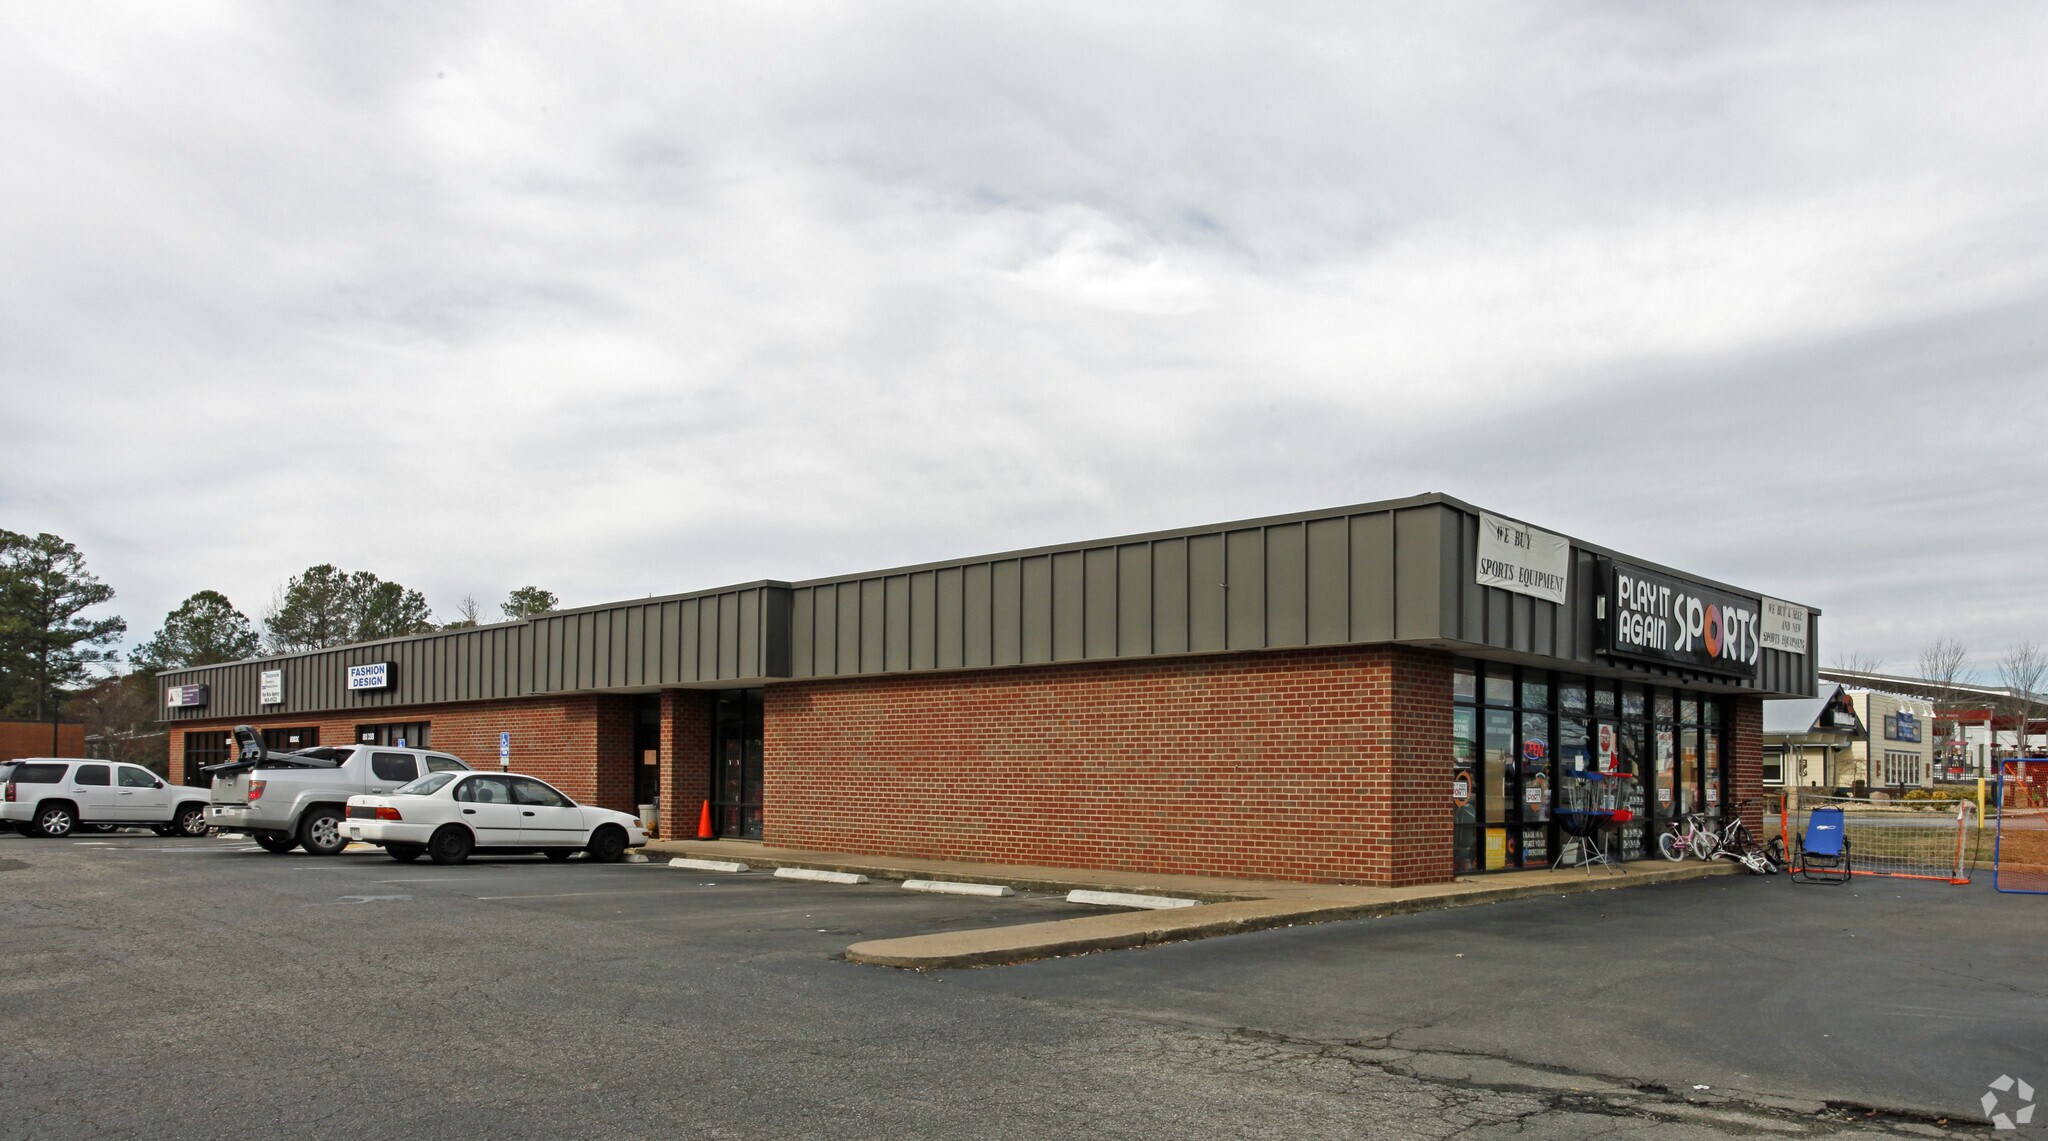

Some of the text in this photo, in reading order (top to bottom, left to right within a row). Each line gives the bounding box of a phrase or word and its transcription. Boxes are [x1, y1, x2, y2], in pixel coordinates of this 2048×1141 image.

[1497, 525, 1532, 550] WE BUY
[1480, 557, 1565, 592] SPORTS EQUIPMENT
[1619, 609, 1667, 651] AGAIN
[1673, 593, 1759, 666] SPORTS
[351, 665, 385, 677] FASHION
[353, 676, 382, 687] DESIGN
[1524, 739, 1544, 757] OPEN
